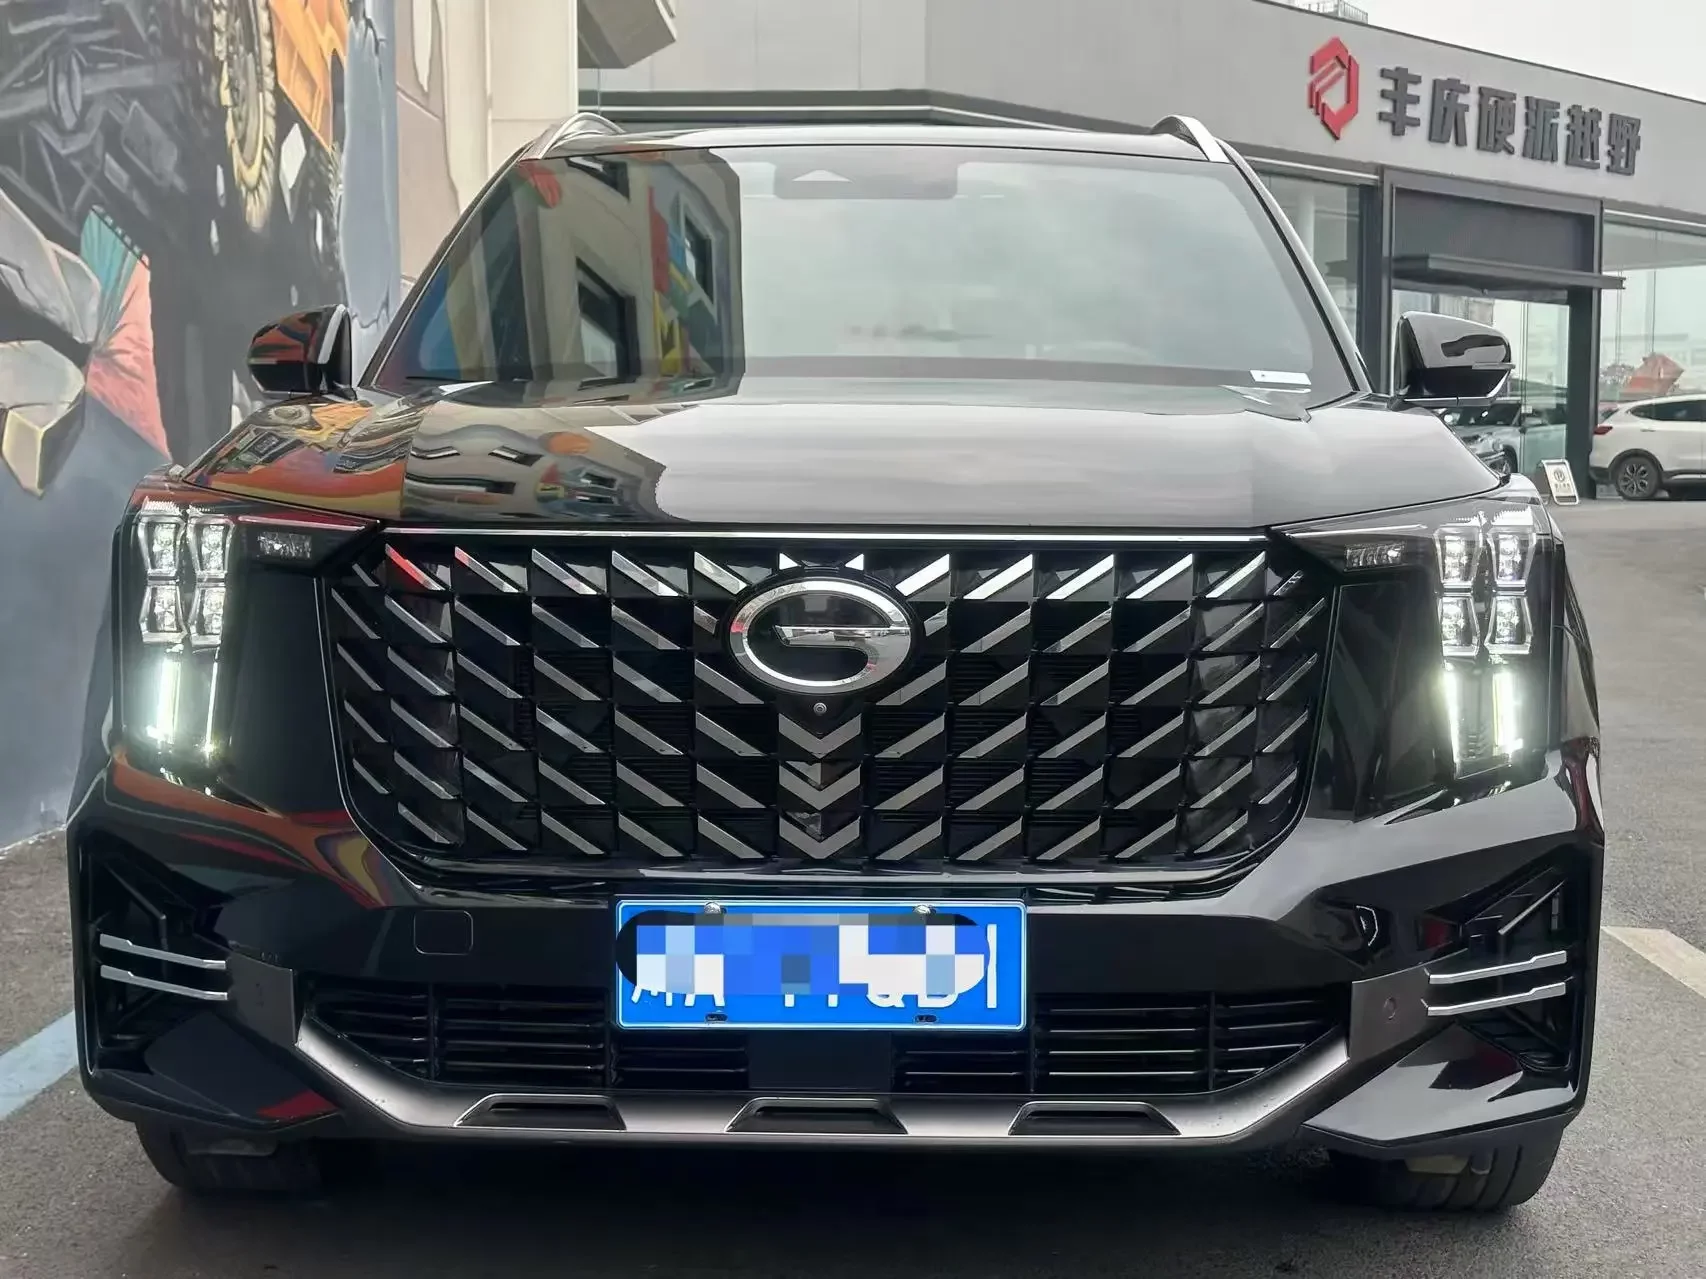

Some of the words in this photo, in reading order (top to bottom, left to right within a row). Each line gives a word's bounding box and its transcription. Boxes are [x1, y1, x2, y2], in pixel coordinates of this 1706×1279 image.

[1378, 67, 1641, 176] 丰庆硬派越野
